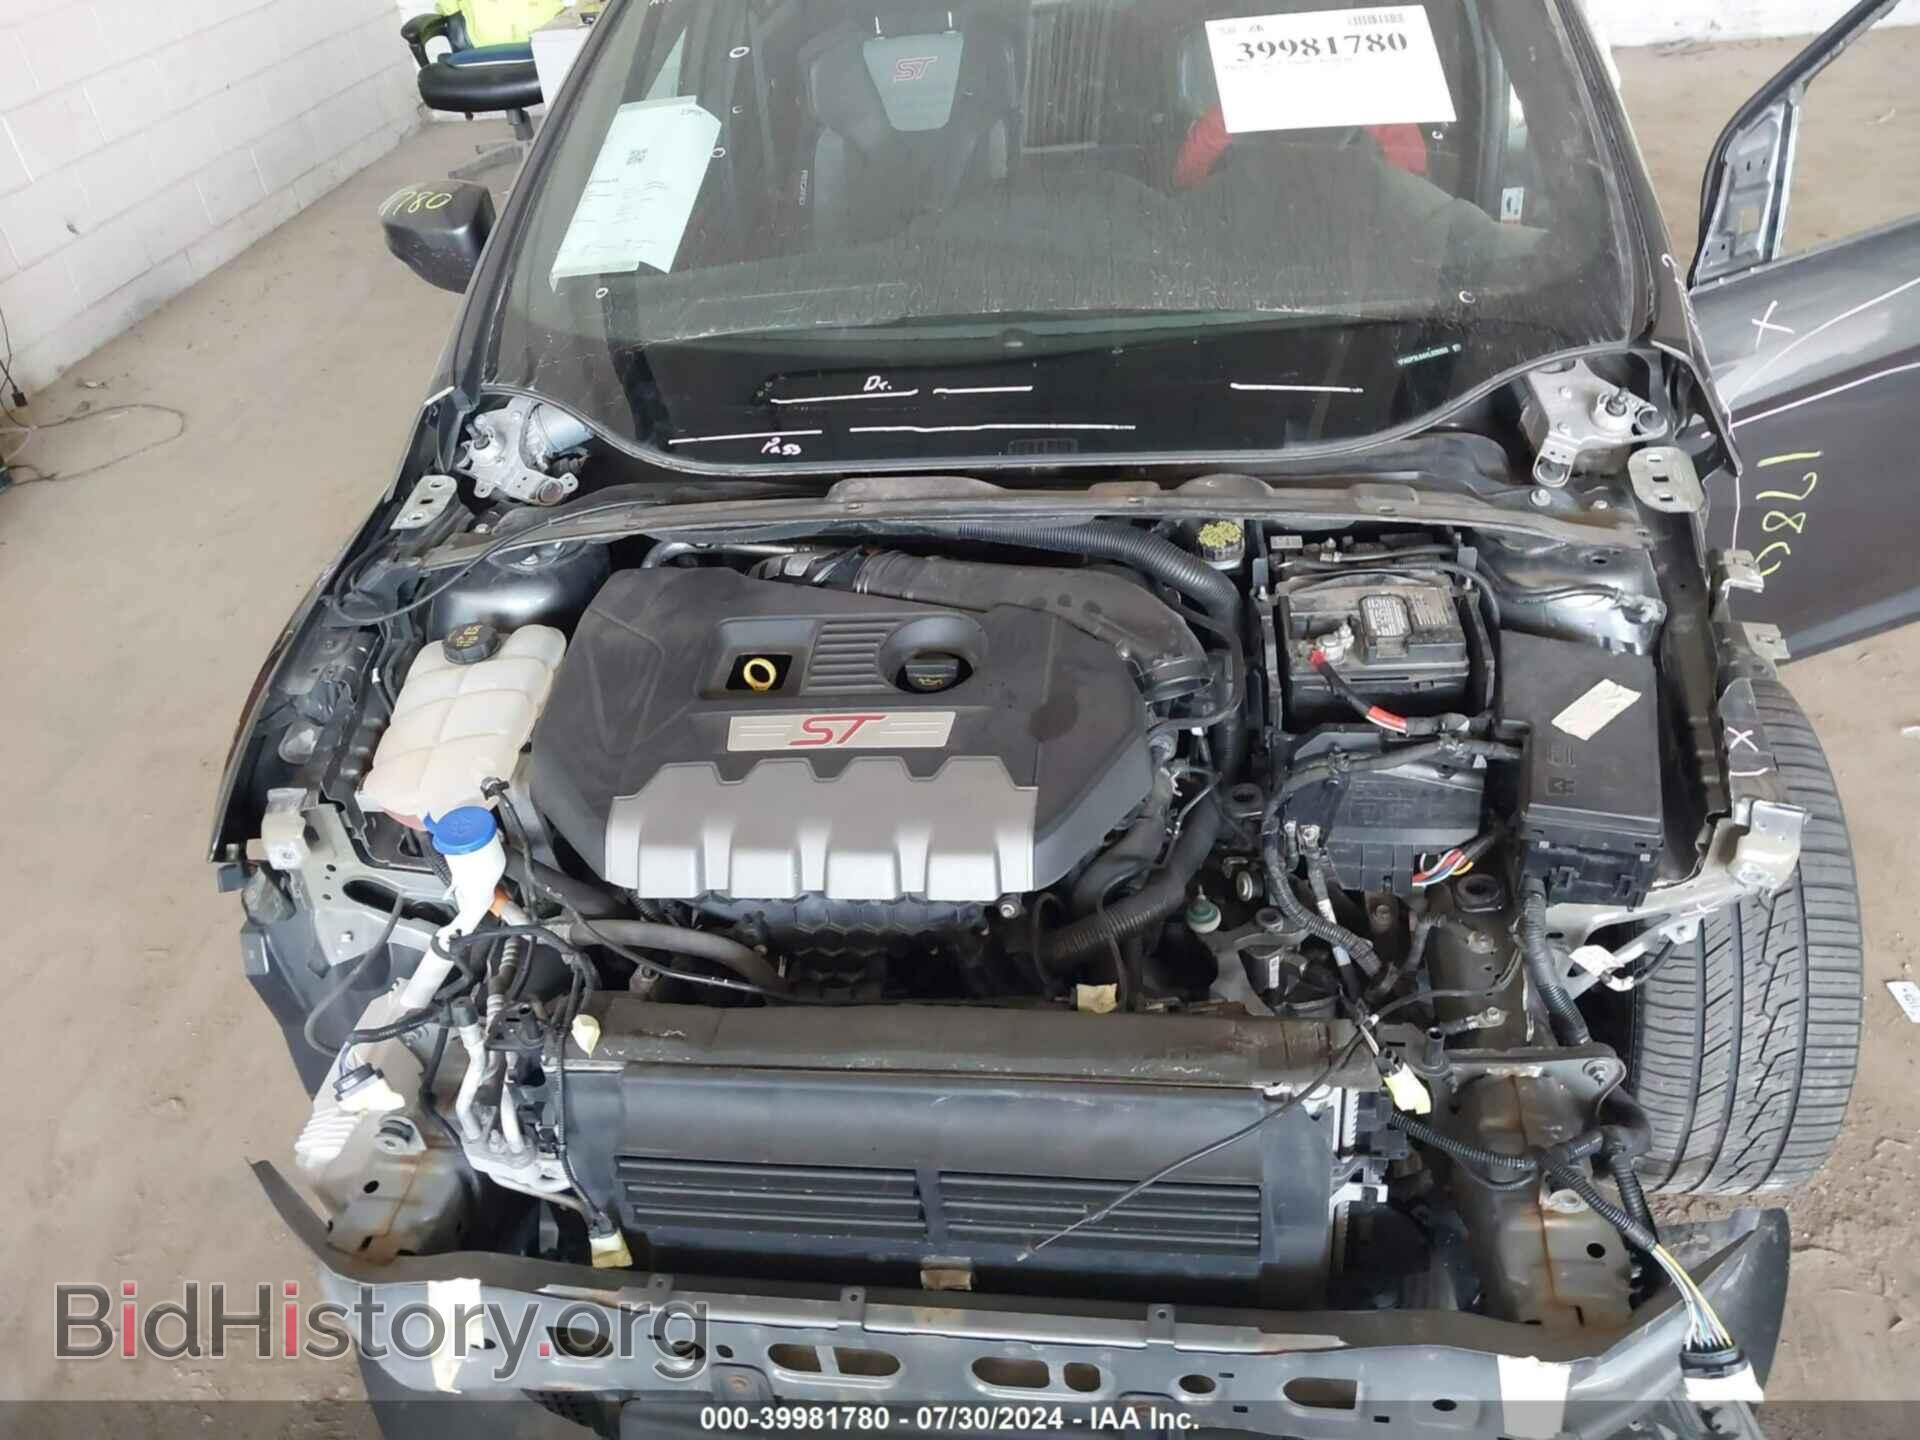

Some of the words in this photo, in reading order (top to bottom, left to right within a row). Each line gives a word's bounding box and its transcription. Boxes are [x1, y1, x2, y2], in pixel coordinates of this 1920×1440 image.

[1236, 32, 1408, 62] 39981780
[893, 56, 938, 82] ST
[787, 715, 887, 746] ST
